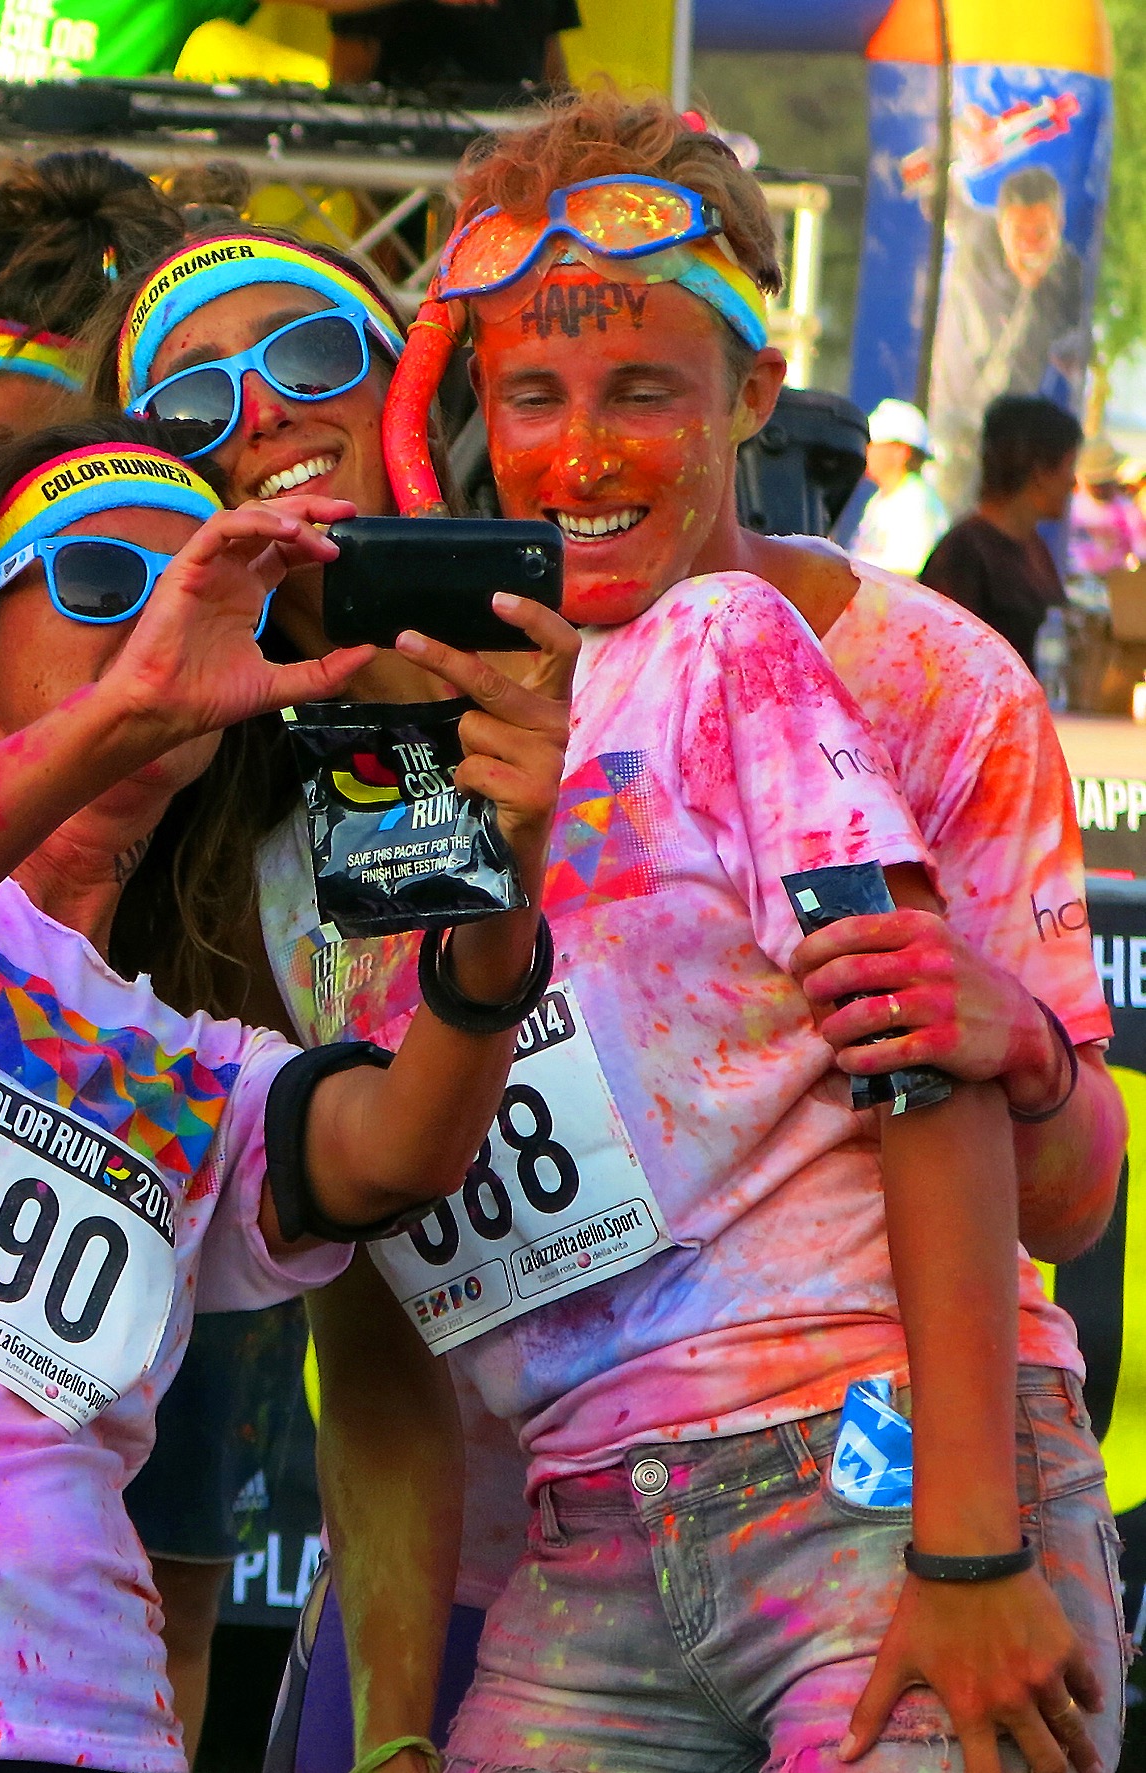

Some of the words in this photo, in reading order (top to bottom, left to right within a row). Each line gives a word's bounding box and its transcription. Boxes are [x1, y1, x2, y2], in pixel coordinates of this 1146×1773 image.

[130, 275, 171, 337] COLOR
[171, 246, 255, 282] RUNNER
[521, 283, 649, 339] HAPPY
[41, 462, 110, 502] COLOR
[110, 458, 192, 487] RUNNER
[392, 743, 440, 772] THE
[404, 766, 457, 799] COL
[411, 790, 456, 830] RUN
[347, 849, 372, 868] SAVE
[372, 846, 393, 865] THIS
[394, 842, 429, 859] PACKET
[430, 838, 449, 853] FOR
[449, 835, 470, 849] THE
[361, 866, 392, 884] FINISH
[393, 864, 413, 880] LINE
[513, 999, 567, 1054] 014
[48, 1125, 107, 1178] RUN
[576, 1222, 607, 1250] dello
[602, 1207, 643, 1239] Sport
[592, 1248, 612, 1261] della
[612, 1241, 629, 1253] vita
[560, 1262, 577, 1275] rosa
[414, 1276, 482, 1325] EXPO
[4, 1358, 24, 1376] Tutto
[30, 1376, 45, 1390] rosa
[57, 1367, 86, 1397] dello
[59, 1394, 78, 1411] della
